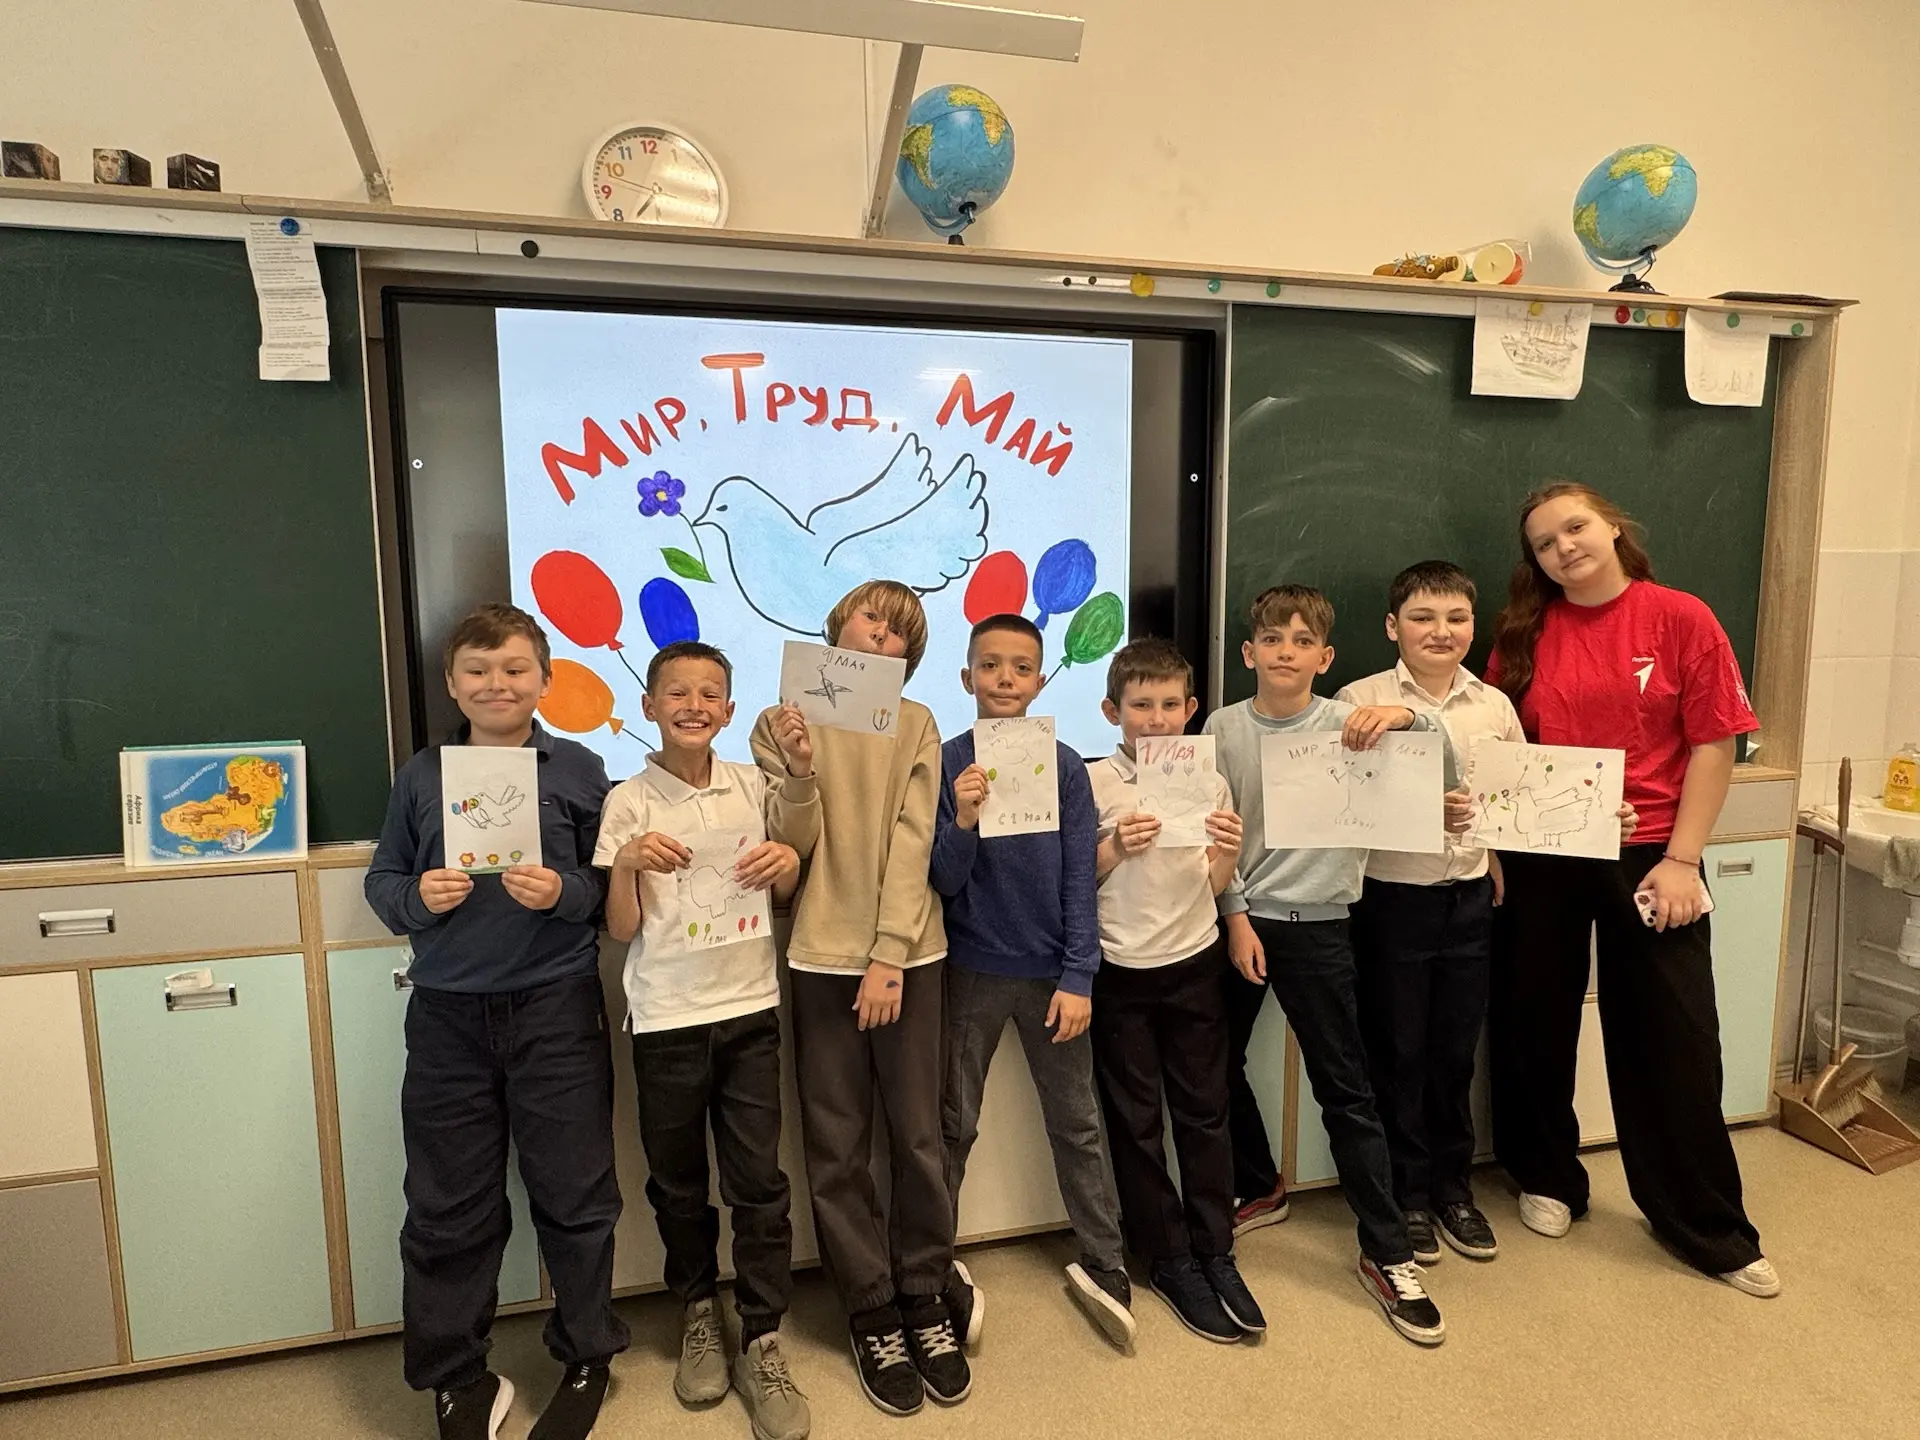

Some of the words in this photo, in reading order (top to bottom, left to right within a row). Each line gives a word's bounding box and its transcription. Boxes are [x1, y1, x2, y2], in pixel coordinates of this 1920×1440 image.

[618, 146, 632, 160] 11
[640, 140, 658, 154] 12
[605, 162, 624, 177] 10
[601, 185, 612, 199] 9
[612, 208, 624, 222] 8
[822, 647, 835, 663] 1
[1140, 740, 1152, 766] 1
